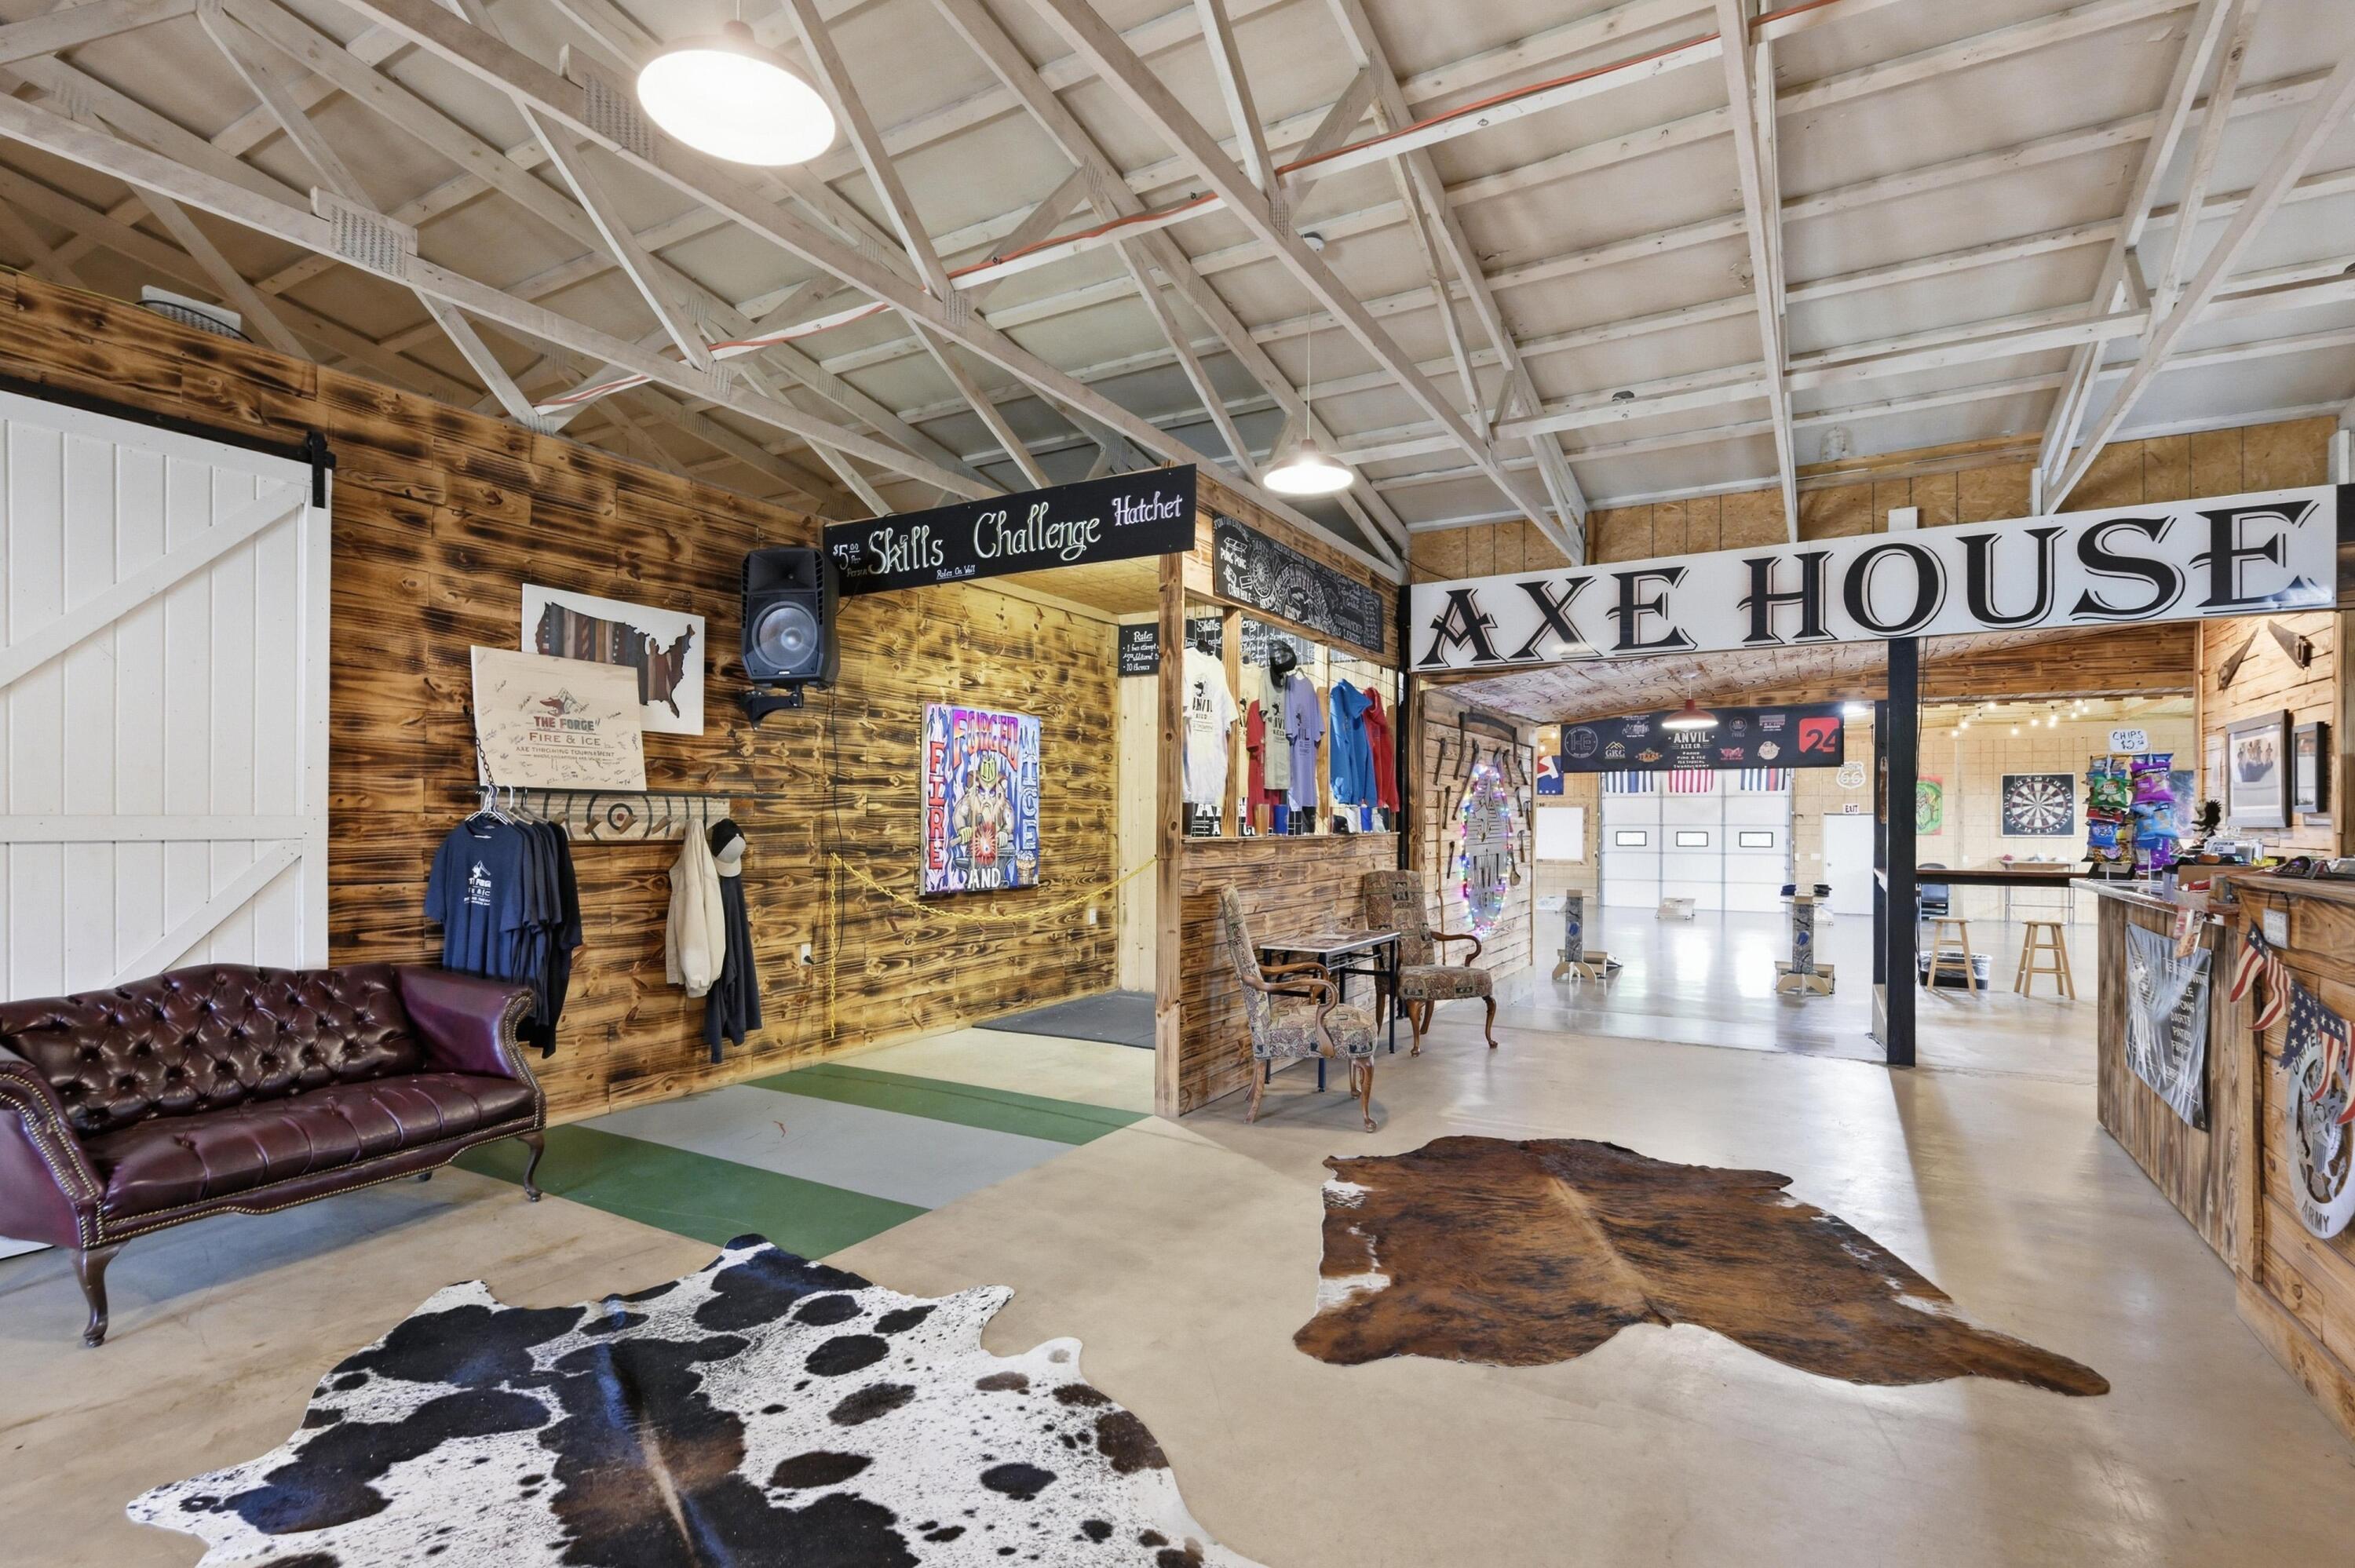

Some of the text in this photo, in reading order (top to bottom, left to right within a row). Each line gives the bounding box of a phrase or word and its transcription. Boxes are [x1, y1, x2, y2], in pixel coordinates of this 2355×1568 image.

[1112, 491, 1183, 527] Hatchet
[869, 501, 1101, 574] Skills Challenge
[1416, 566, 1698, 669] AXE
[1736, 500, 2333, 647] HOUSE
[534, 716, 594, 731] THE FORGE
[1674, 731, 1710, 743] ANVIL
[2112, 730, 2144, 740] CHIPS
[529, 732, 601, 746] FIRE & ICE
[951, 709, 1019, 772] FORGED
[1841, 771, 1860, 784] 66
[928, 741, 947, 870] FIRE
[1022, 753, 1039, 850] ICE
[1846, 804, 1858, 813] EXIT
[967, 867, 1002, 889] AND
[2302, 1199, 2330, 1233] ARMY
